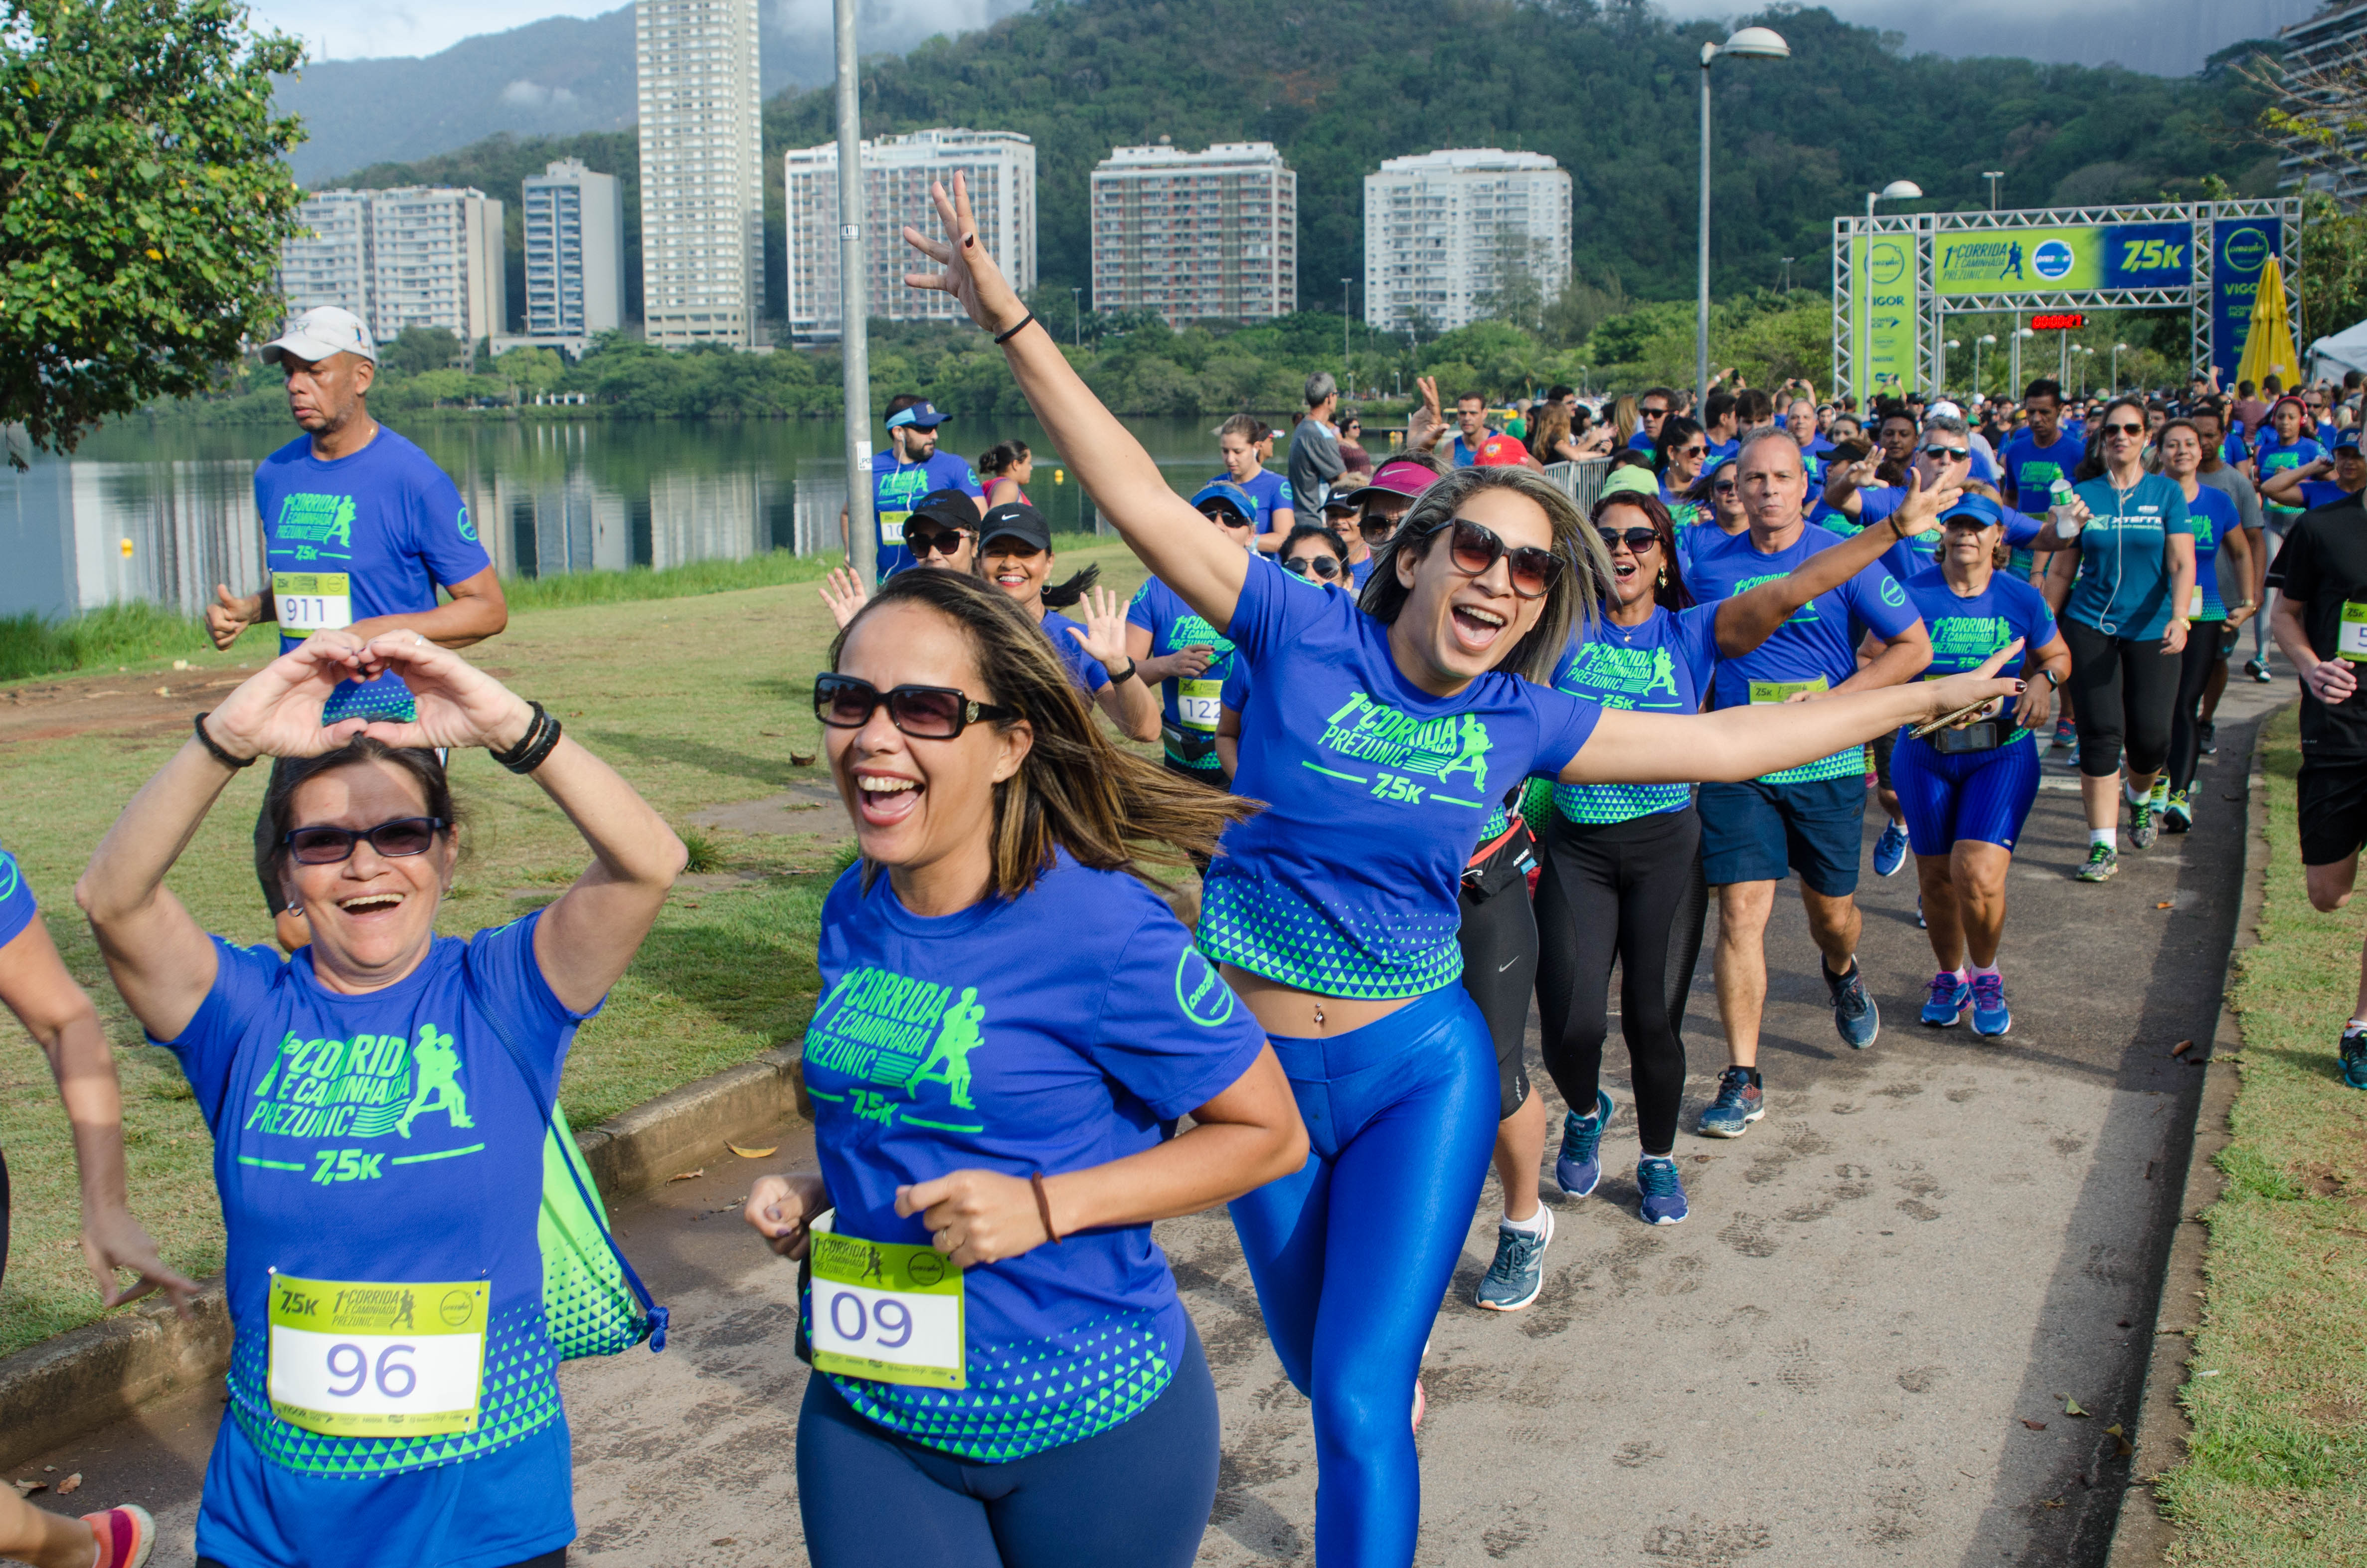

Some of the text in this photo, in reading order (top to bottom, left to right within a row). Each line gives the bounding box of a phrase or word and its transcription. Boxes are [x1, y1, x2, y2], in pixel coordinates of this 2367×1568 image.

[1957, 242, 2008, 258] CORRIDA
[2121, 239, 2185, 273] 7,5K
[1943, 269, 1983, 280] PREZUNIC
[1960, 257, 2006, 268] CAMINHADA
[2224, 283, 2259, 295] VIGO
[287, 598, 325, 622] 911
[1181, 630, 1189, 638] E
[1944, 616, 1996, 632] CORRIDA
[1941, 632, 1994, 643] E CAMINHADA
[1572, 642, 1654, 667] 1ª CORRIDA
[1567, 667, 1623, 691] PREZUNIC
[1585, 660, 1652, 680] E CAMINHADA
[1327, 691, 1370, 725] 1ª
[1600, 694, 1636, 709] 7,5K
[1317, 725, 1412, 768] PREZUNIC
[1370, 772, 1426, 805] 7,5K
[812, 966, 954, 1029] 1ª CORRIDA
[825, 1006, 932, 1057] E CAMINHADA
[804, 1028, 877, 1079] PREZUNIC
[275, 1073, 301, 1100] E
[244, 1100, 356, 1139] PREZUNIC
[311, 1148, 385, 1186] 7,5K
[822, 1238, 866, 1258] CORRIDA
[280, 1290, 320, 1316] 7,5K
[346, 1289, 400, 1305] CORRIDA
[331, 1315, 372, 1327] PREZUNIC
[350, 1306, 397, 1316] CAMINHADA
[831, 1291, 913, 1348] 09
[327, 1343, 417, 1398] 96
